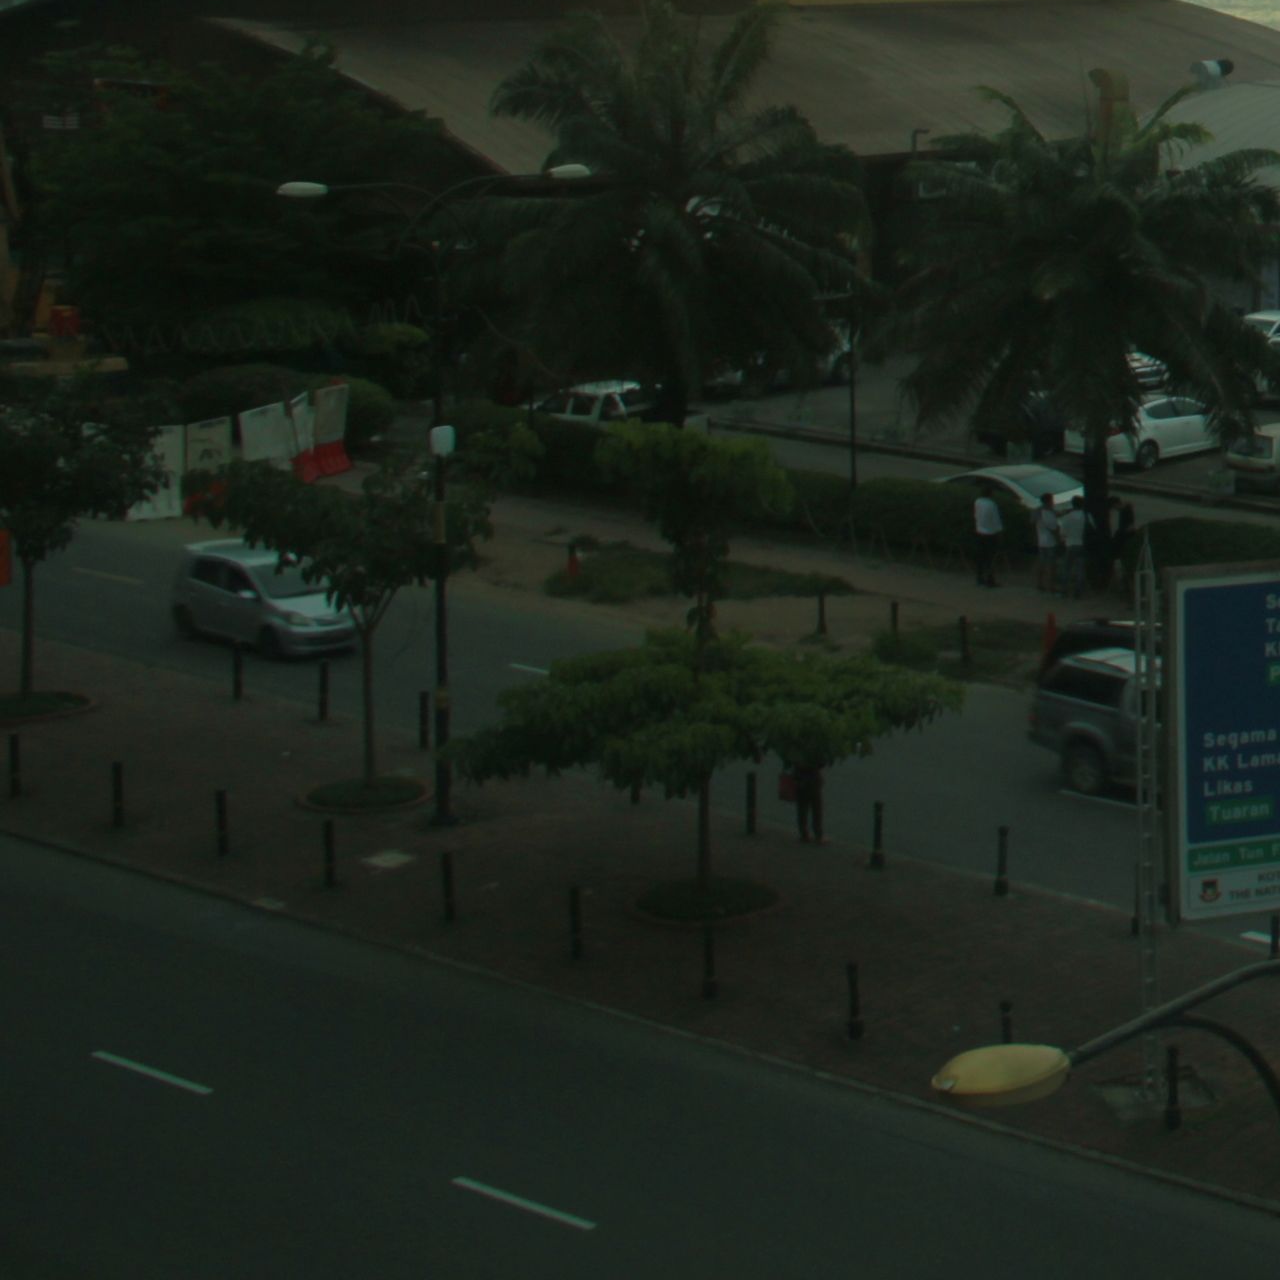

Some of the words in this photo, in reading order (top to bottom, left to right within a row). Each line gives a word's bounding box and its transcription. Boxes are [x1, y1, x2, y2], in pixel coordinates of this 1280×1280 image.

[1203, 728, 1278, 750] Segama
[1203, 754, 1230, 772] KK
[1203, 779, 1253, 797] Likas
[1209, 802, 1270, 822] Tuaran
[1195, 850, 1231, 866] Jalan
[1238, 844, 1265, 861] Tun
[1229, 886, 1252, 901] THE
